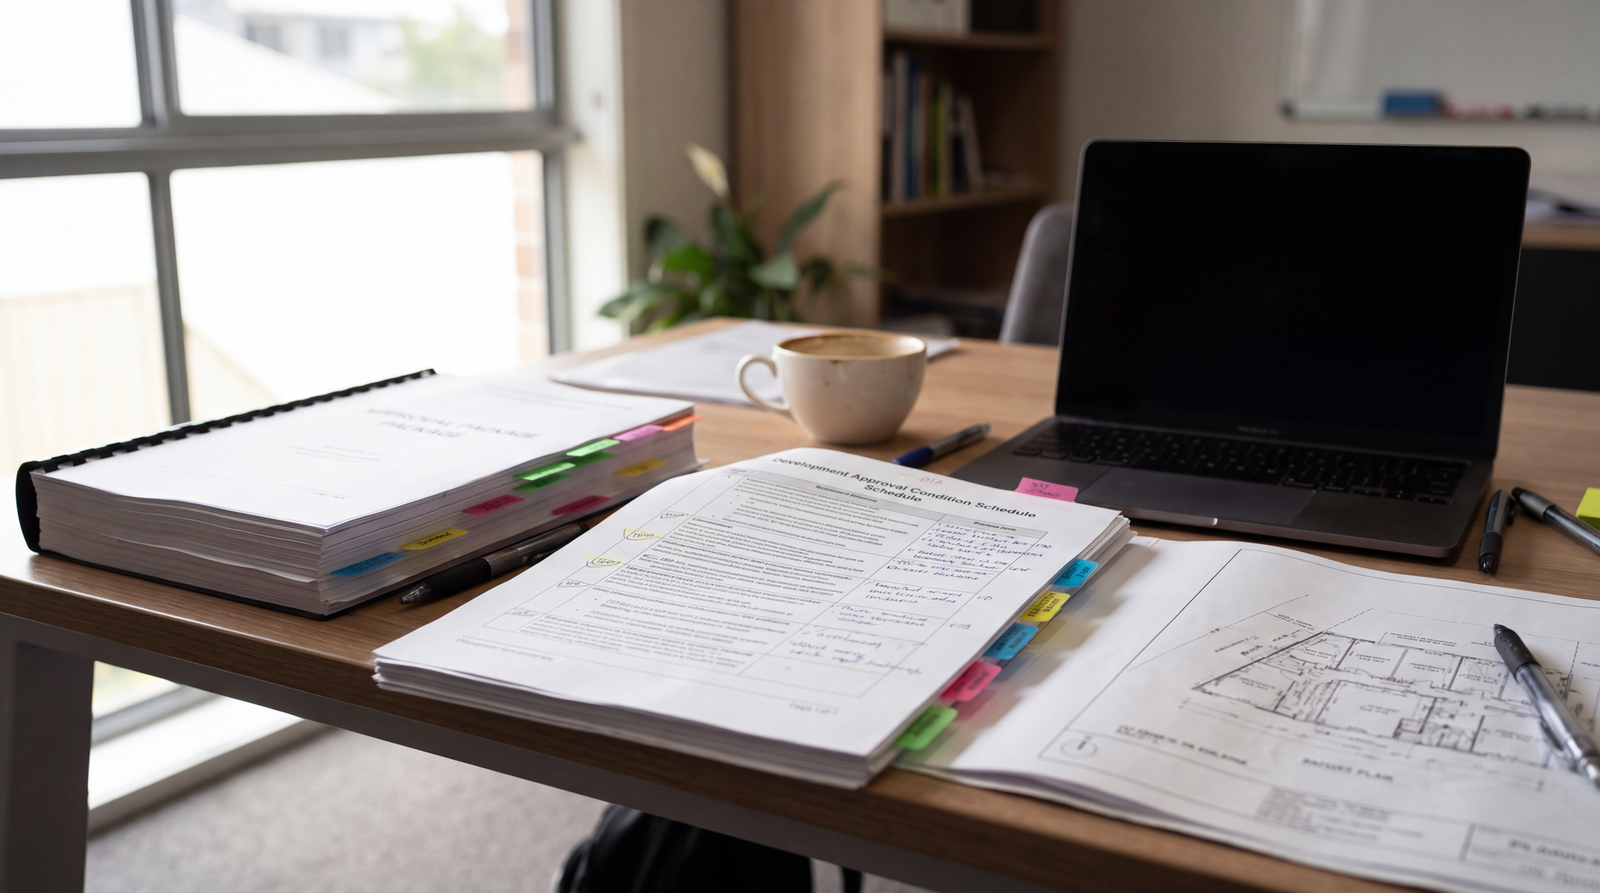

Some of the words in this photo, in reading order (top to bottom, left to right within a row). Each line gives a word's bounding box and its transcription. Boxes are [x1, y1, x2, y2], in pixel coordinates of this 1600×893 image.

[773, 457, 850, 477] Development
[850, 473, 909, 491] Approval
[910, 487, 972, 506] Condition
[975, 501, 1037, 518] Schedule
[864, 484, 922, 502] Schedule
